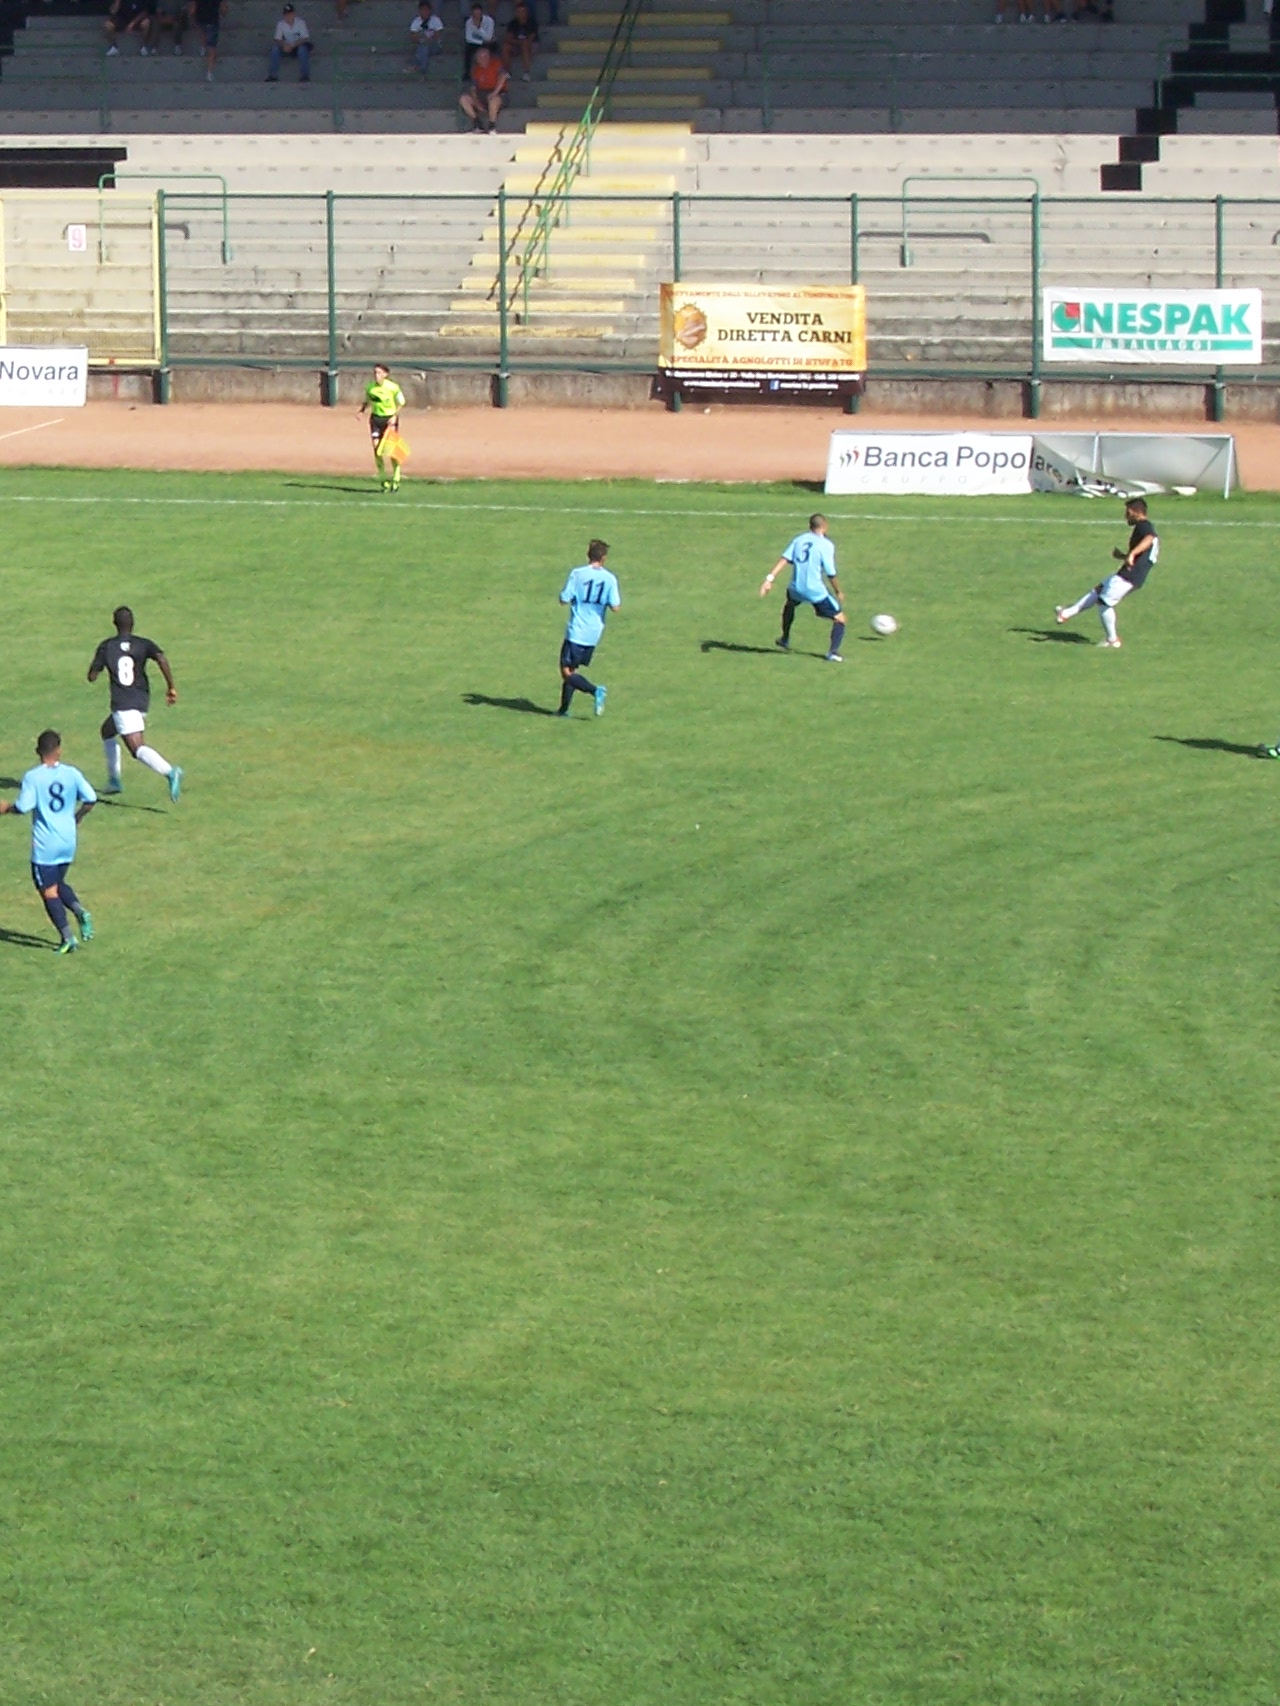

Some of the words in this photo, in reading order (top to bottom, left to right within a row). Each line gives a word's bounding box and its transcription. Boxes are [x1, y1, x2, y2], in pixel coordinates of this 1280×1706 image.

[746, 312, 823, 326] VENDITA
[1083, 302, 1252, 335] NESPAK
[718, 329, 793, 342] DIRETTA
[798, 331, 852, 343] CARNI
[732, 356, 791, 366] AGNOLOTTI
[793, 357, 803, 366] DI
[805, 357, 853, 367] STUFATO
[864, 446, 948, 467] Banca
[796, 542, 813, 564] 3
[582, 579, 605, 604] 11
[117, 655, 135, 686] 8
[49, 781, 65, 813] 8
